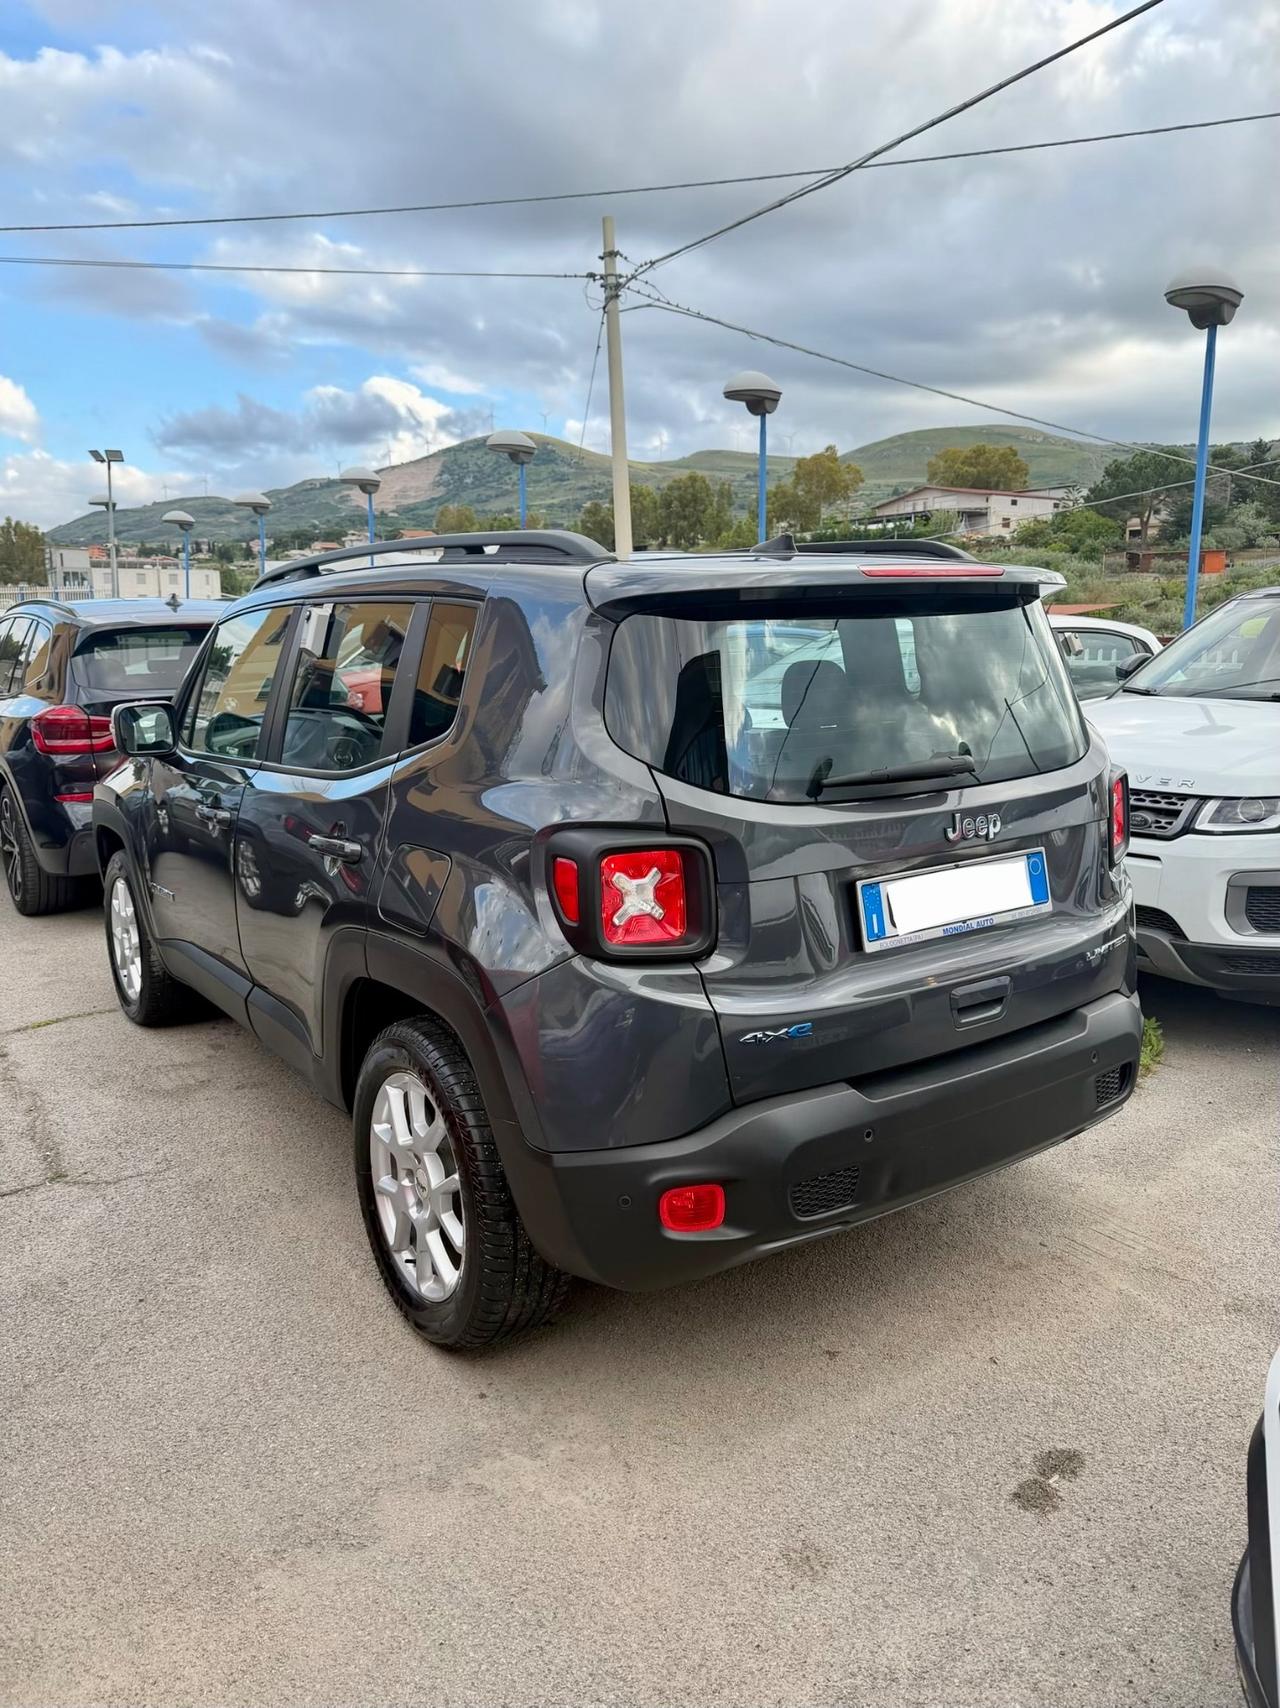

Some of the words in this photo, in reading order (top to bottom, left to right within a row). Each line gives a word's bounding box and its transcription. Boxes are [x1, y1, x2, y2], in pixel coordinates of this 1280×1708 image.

[945, 813, 1001, 841] Jeep
[942, 923, 975, 936] MONDIAL
[976, 918, 994, 928] AUTO
